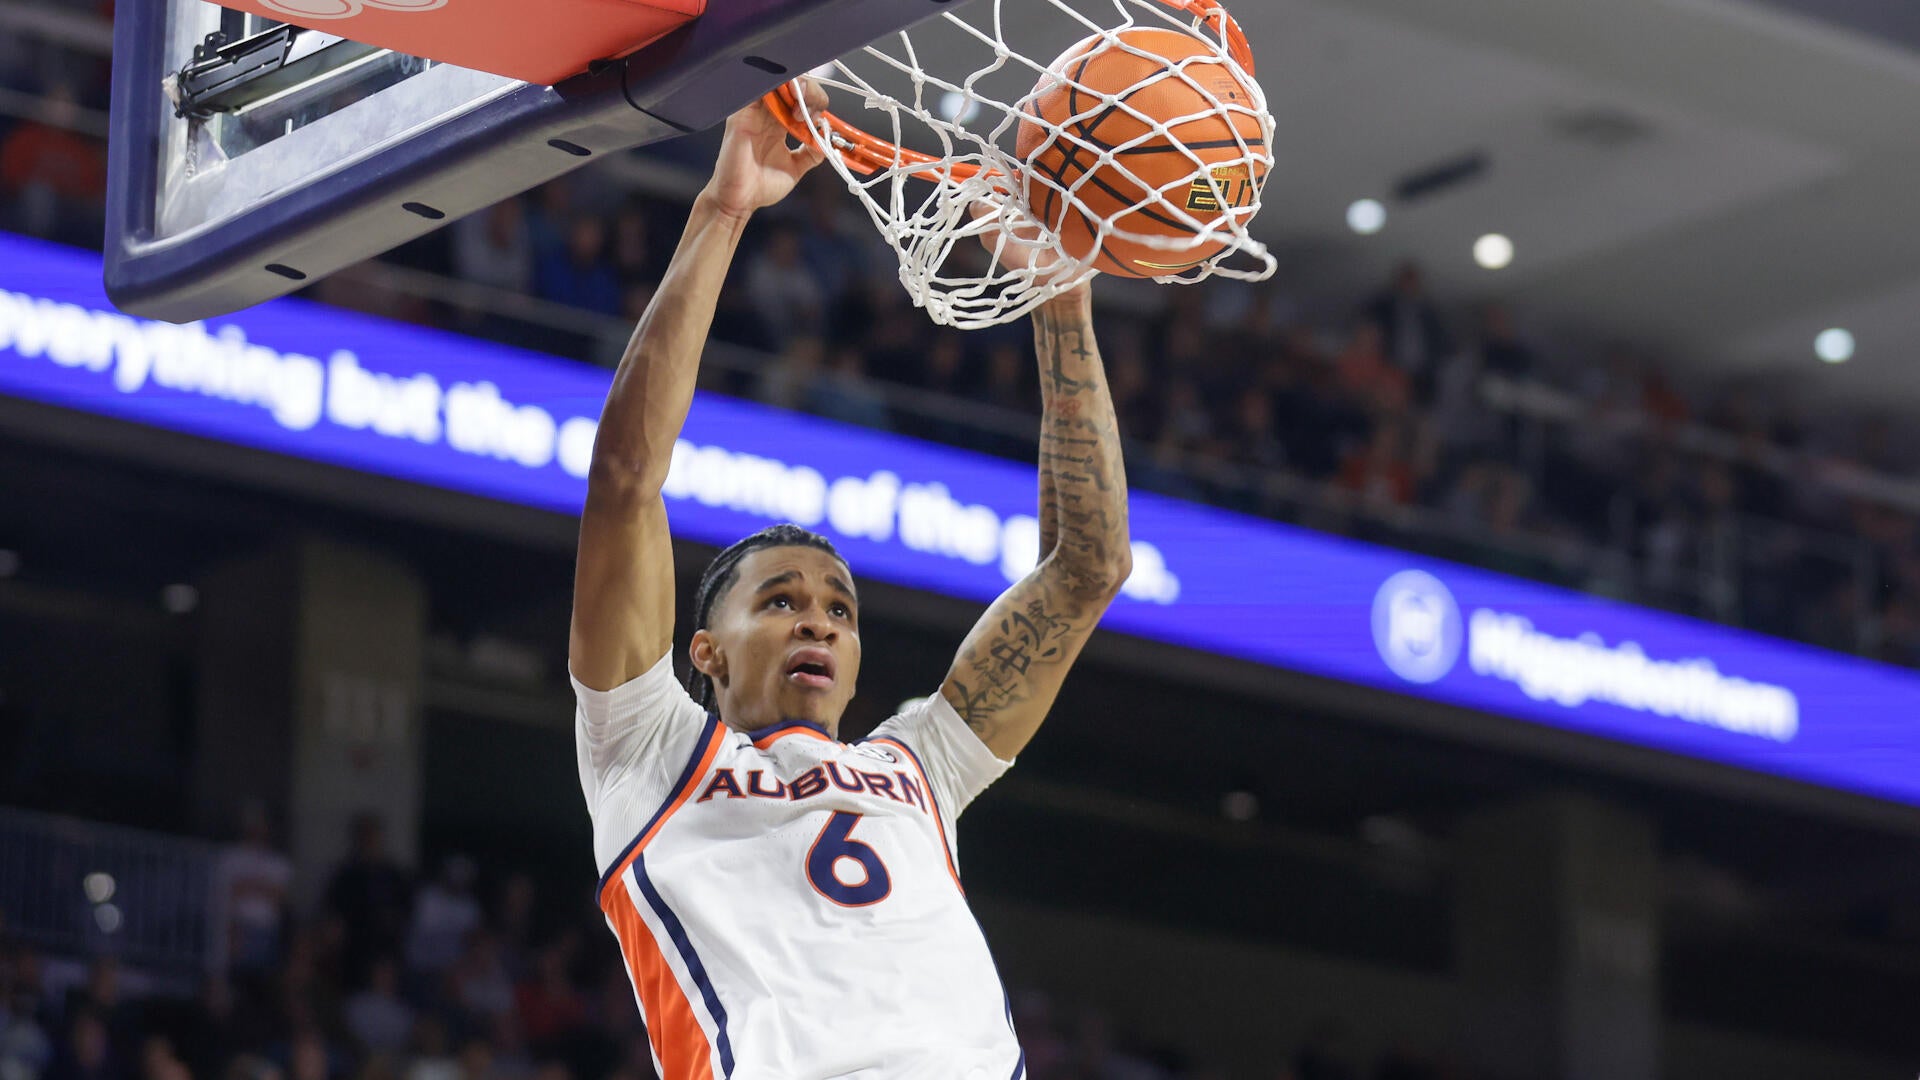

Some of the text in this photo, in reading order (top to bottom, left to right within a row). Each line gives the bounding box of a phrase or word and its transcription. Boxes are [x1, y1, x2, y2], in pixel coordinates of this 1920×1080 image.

[328, 350, 441, 444] but
[446, 383, 555, 468] the
[558, 417, 826, 527] ocome
[830, 470, 900, 542] of
[902, 482, 1001, 565] the
[1469, 608, 1798, 743] Higginbotham
[696, 760, 928, 814] AUBURN
[805, 809, 892, 908] 6
